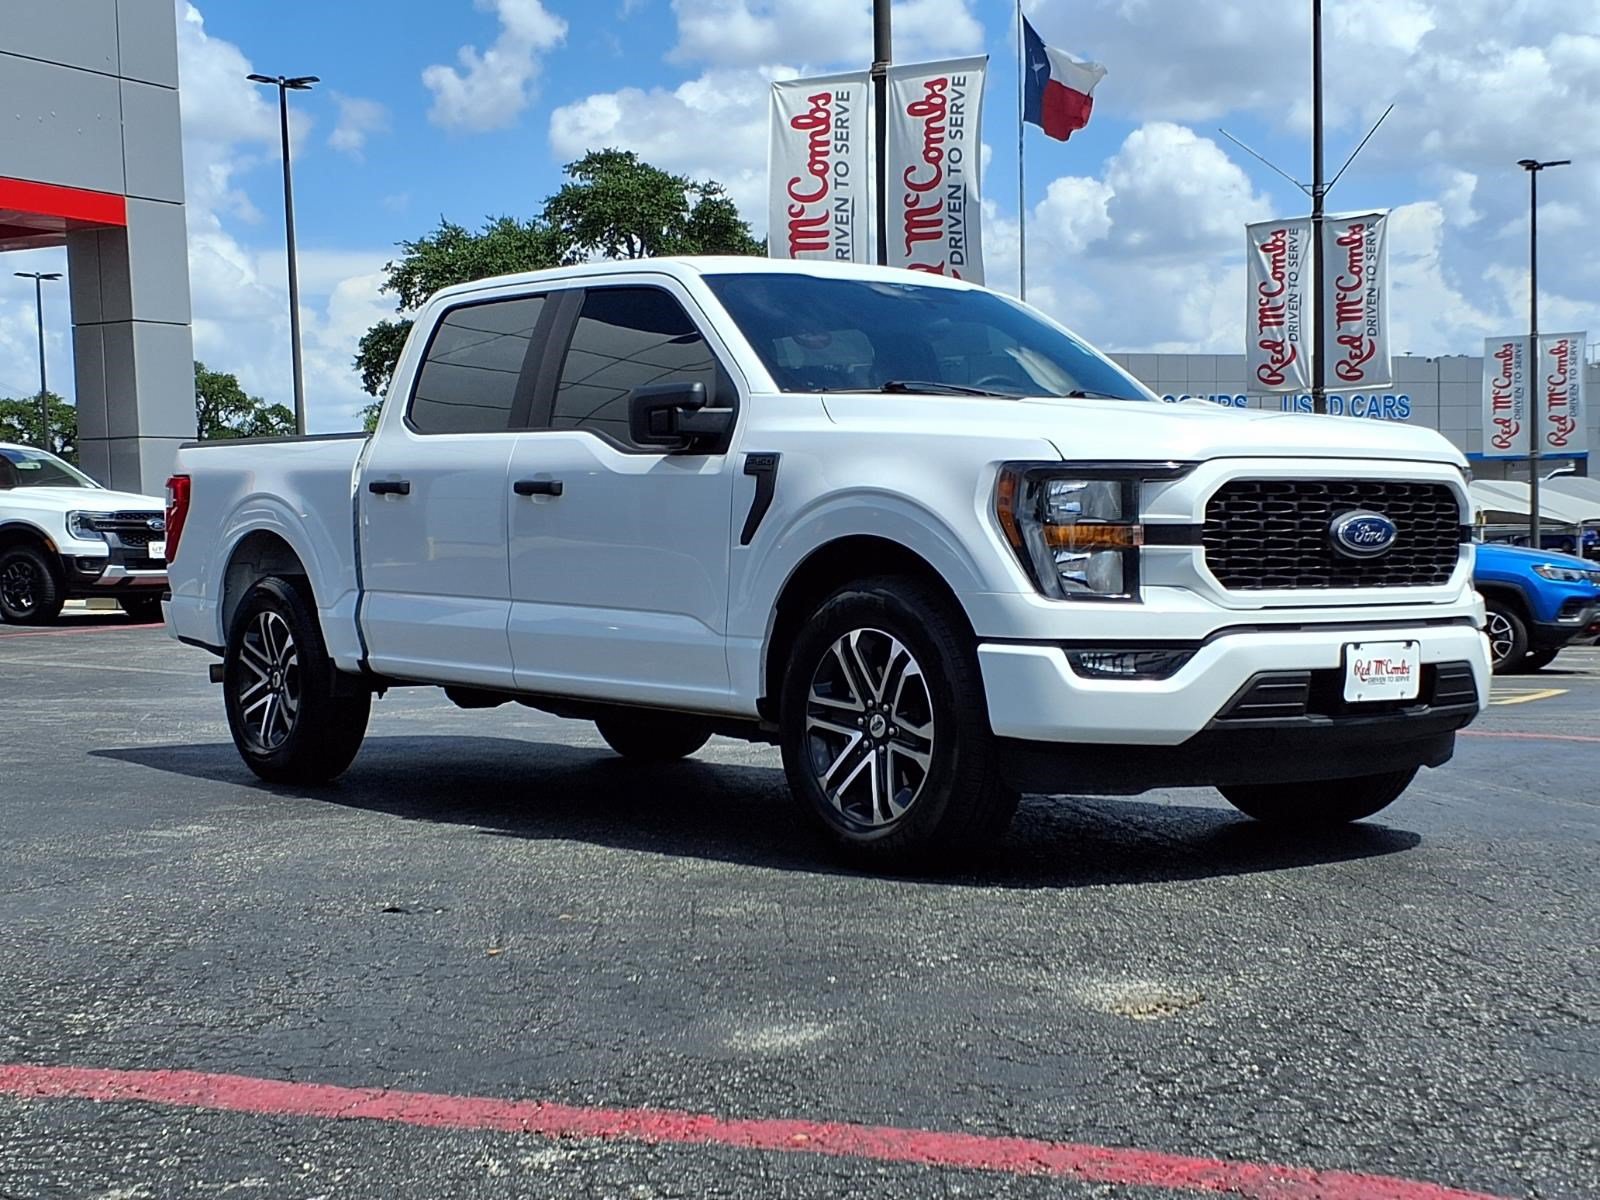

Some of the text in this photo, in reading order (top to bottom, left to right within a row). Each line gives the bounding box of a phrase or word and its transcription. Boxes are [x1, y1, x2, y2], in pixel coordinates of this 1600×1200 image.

[834, 90, 850, 260] RIVEN TO SERVE
[947, 75, 967, 266] DRIVEN TO SERVE
[1288, 227, 1299, 342] DRIVEN TO SERVE
[1366, 222, 1377, 337] DRIVEN TO SERVE
[1257, 338, 1297, 385] Red
[1335, 334, 1376, 381] Red
[1282, 394, 1410, 419] USD CARS
[1491, 417, 1520, 449] Red
[1547, 415, 1576, 447] Red
[1354, 522, 1386, 543] Ford
[1354, 658, 1371, 682] Red
